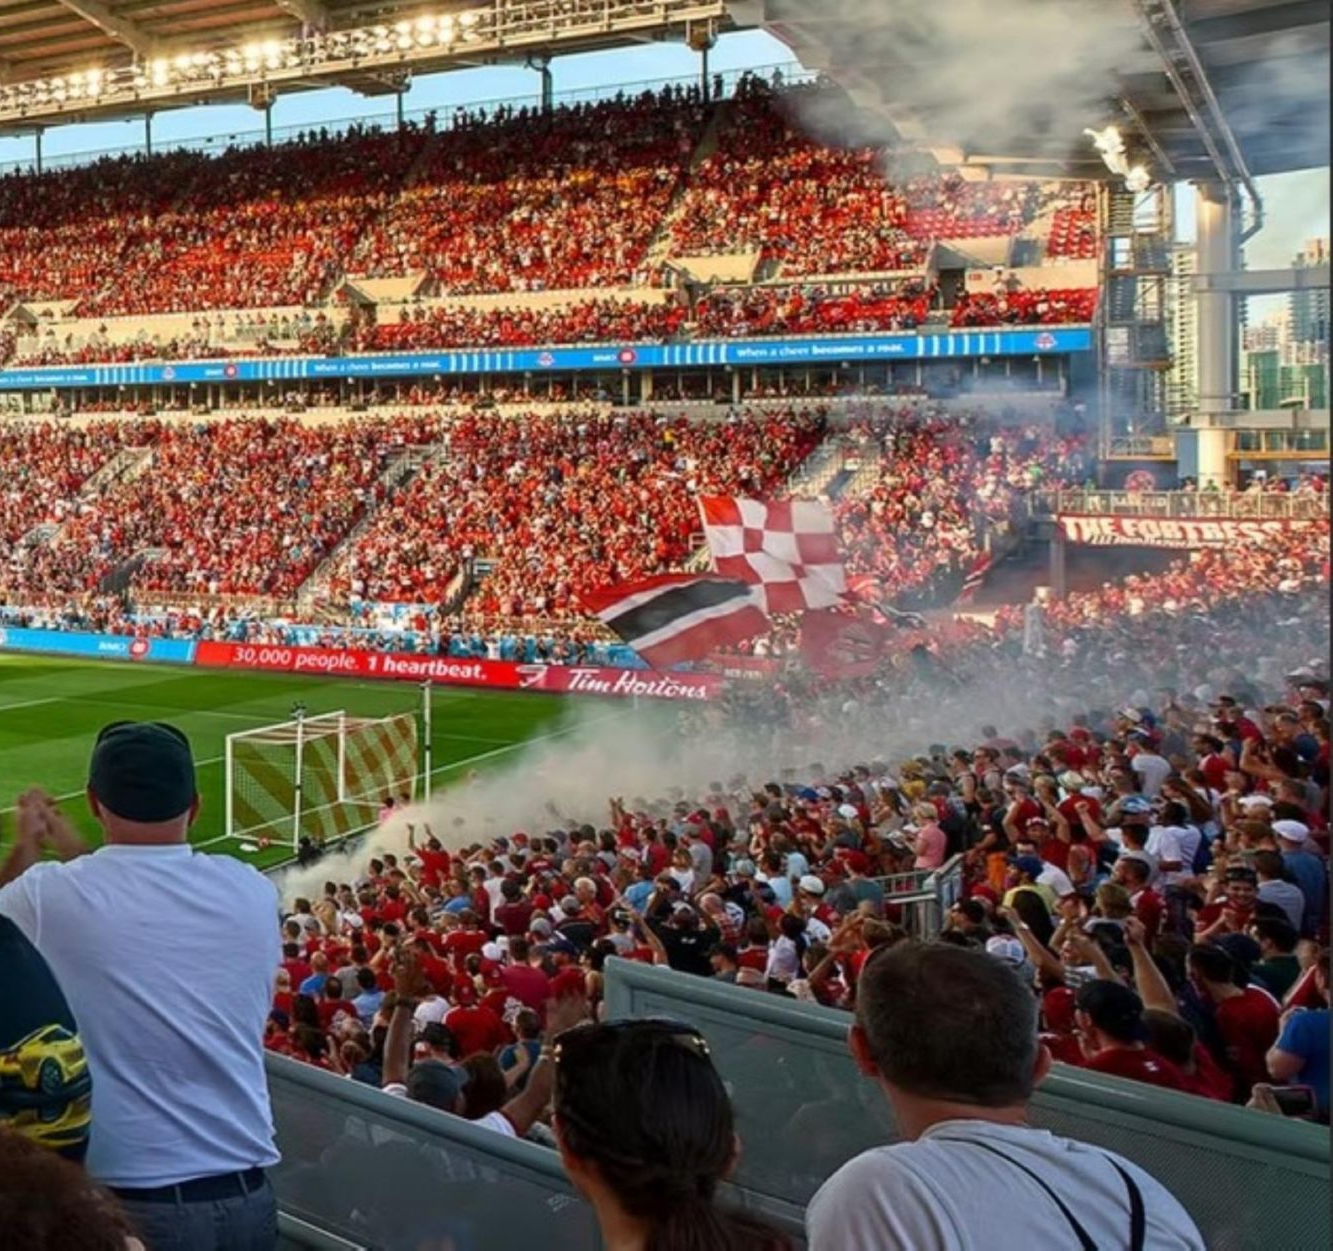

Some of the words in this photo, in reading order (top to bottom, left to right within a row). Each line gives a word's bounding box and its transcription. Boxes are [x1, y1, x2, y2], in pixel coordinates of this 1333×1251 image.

[736, 349, 766, 358] When
[779, 347, 809, 356] cheer
[812, 345, 864, 355] becomes
[1061, 517, 1116, 541] THE
[1121, 519, 1283, 541] FORTRESS
[234, 647, 291, 666] 30,000
[294, 652, 359, 671] people.
[367, 657, 377, 671] 1
[383, 656, 487, 680] heartbeat.
[568, 668, 610, 693] Tim
[611, 670, 708, 699] Hortons
